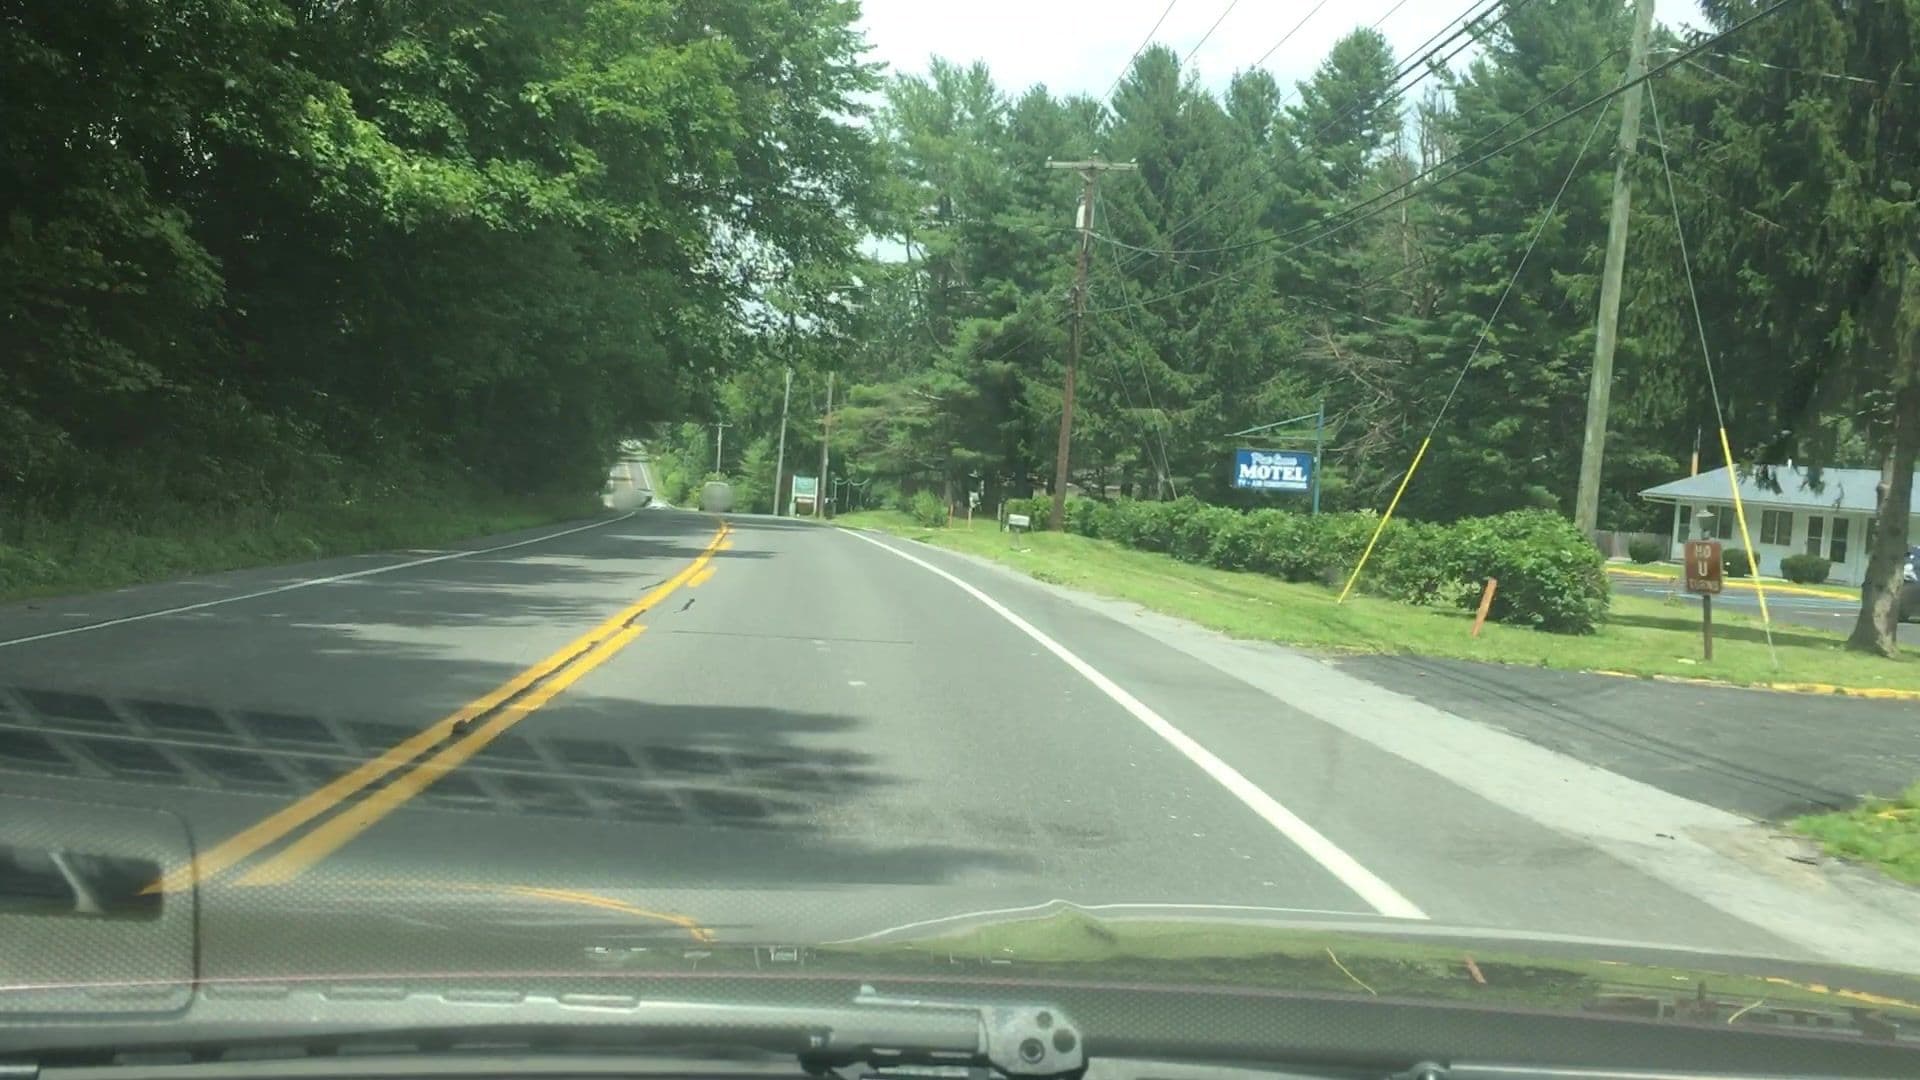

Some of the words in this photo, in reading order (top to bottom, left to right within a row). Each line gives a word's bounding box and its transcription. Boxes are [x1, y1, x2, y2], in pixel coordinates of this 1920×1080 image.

[1239, 464, 1307, 481] MOTEL
[1695, 544, 1711, 558] NO
[1697, 560, 1708, 577] U
